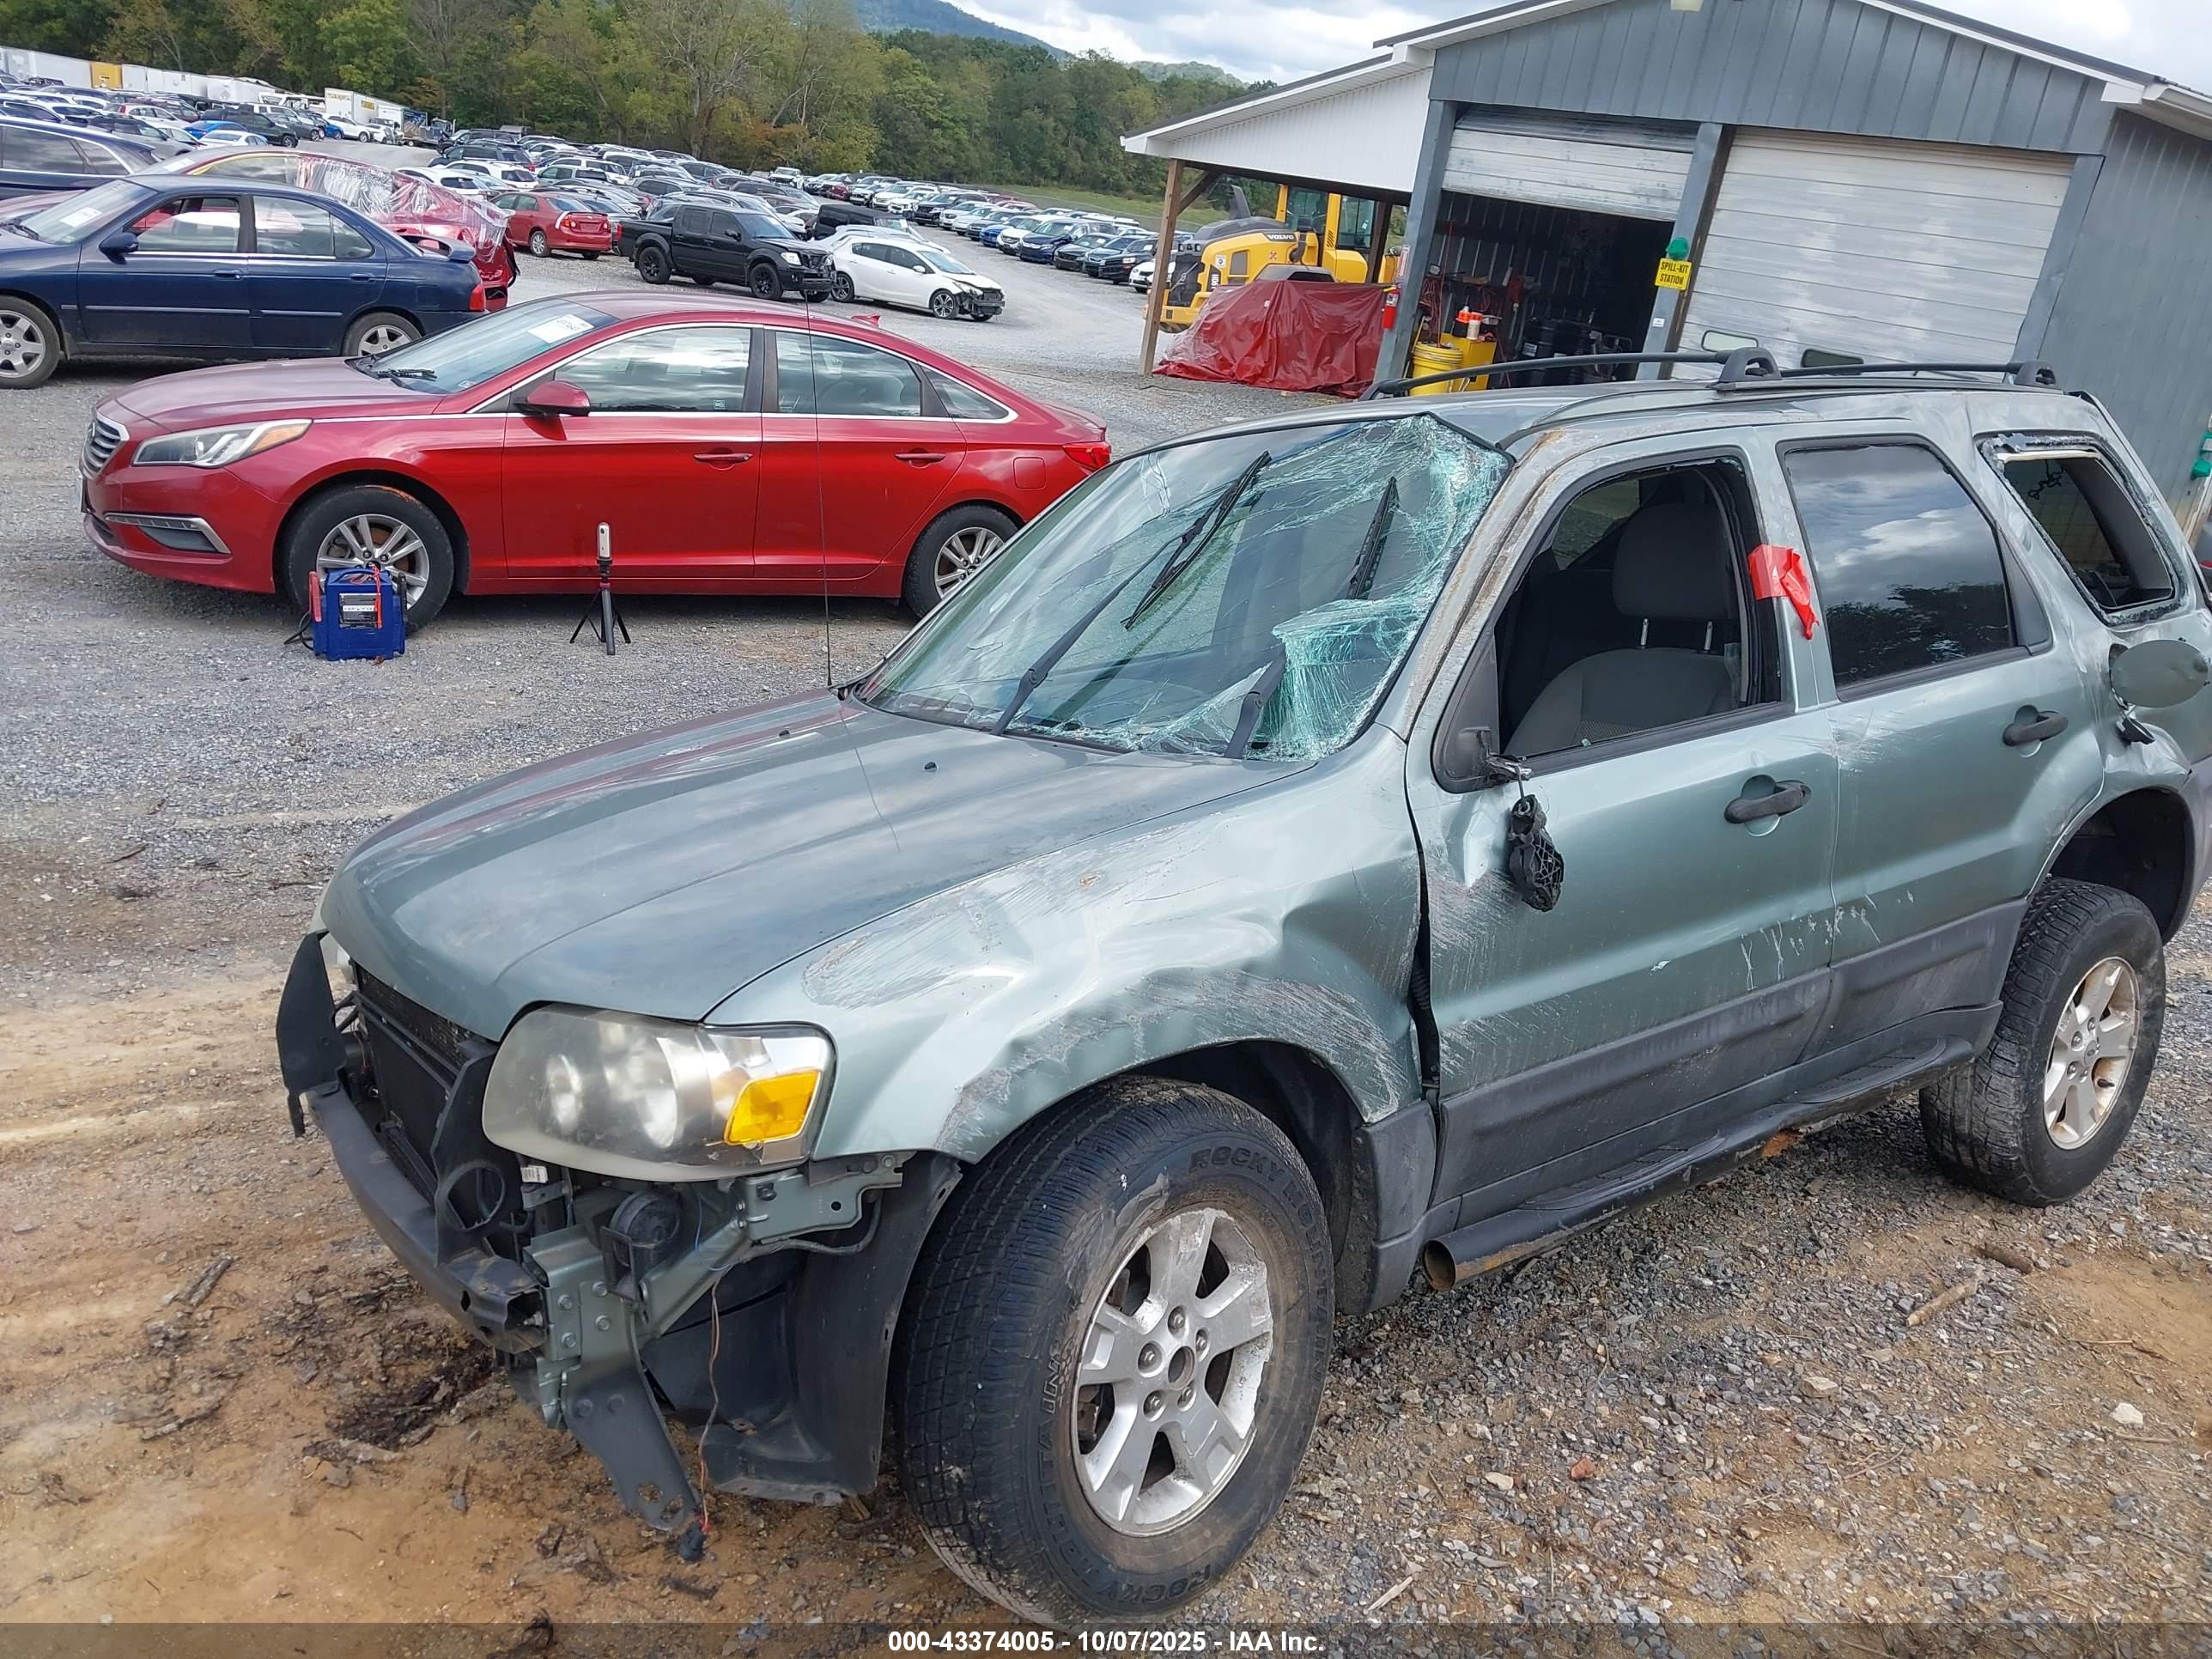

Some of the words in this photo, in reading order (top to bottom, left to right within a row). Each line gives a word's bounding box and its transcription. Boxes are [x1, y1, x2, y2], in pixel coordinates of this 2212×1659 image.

[1659, 273, 1684, 285] STATION
[1661, 261, 1689, 273] SPILL-KIT
[1189, 1146, 1286, 1182] ROCKY
[1095, 1564, 1212, 1605] ROCKY
